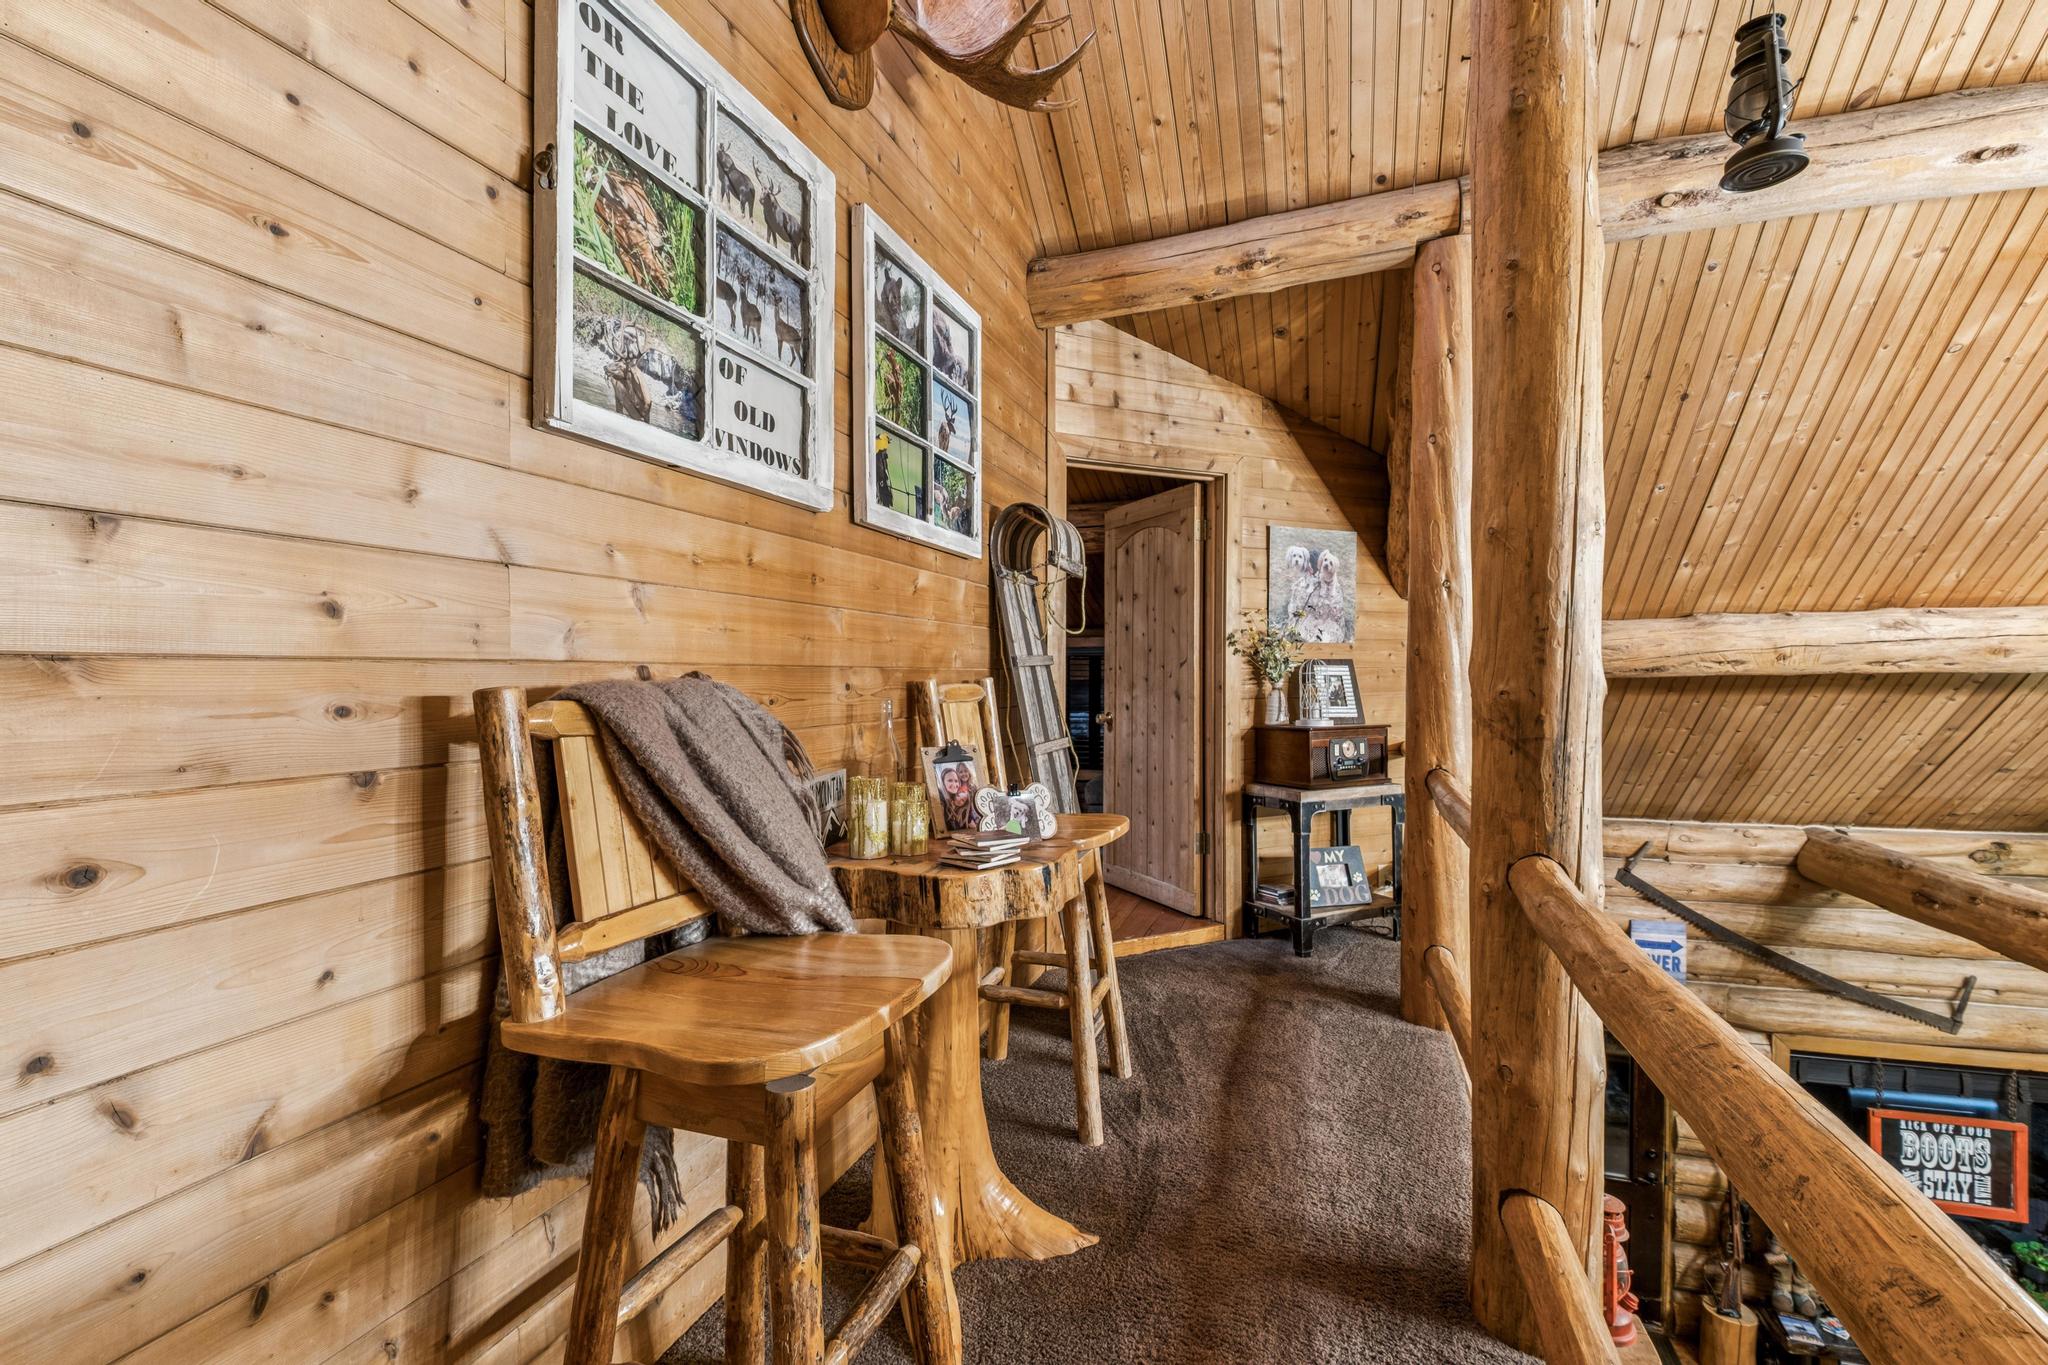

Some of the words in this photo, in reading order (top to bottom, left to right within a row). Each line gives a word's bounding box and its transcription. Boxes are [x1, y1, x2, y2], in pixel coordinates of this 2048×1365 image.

[581, 44, 644, 114] THE
[719, 357, 748, 386] OF
[734, 400, 775, 433] OLD
[1324, 850, 1345, 863] MY
[1325, 884, 1371, 905] DOG
[1650, 953, 1681, 972] VER
[1932, 1122, 1956, 1134] OFF
[1961, 1126, 1992, 1138] YOUR
[1899, 1130, 1993, 1175] BOOTS
[1923, 1169, 1973, 1203] STAY
